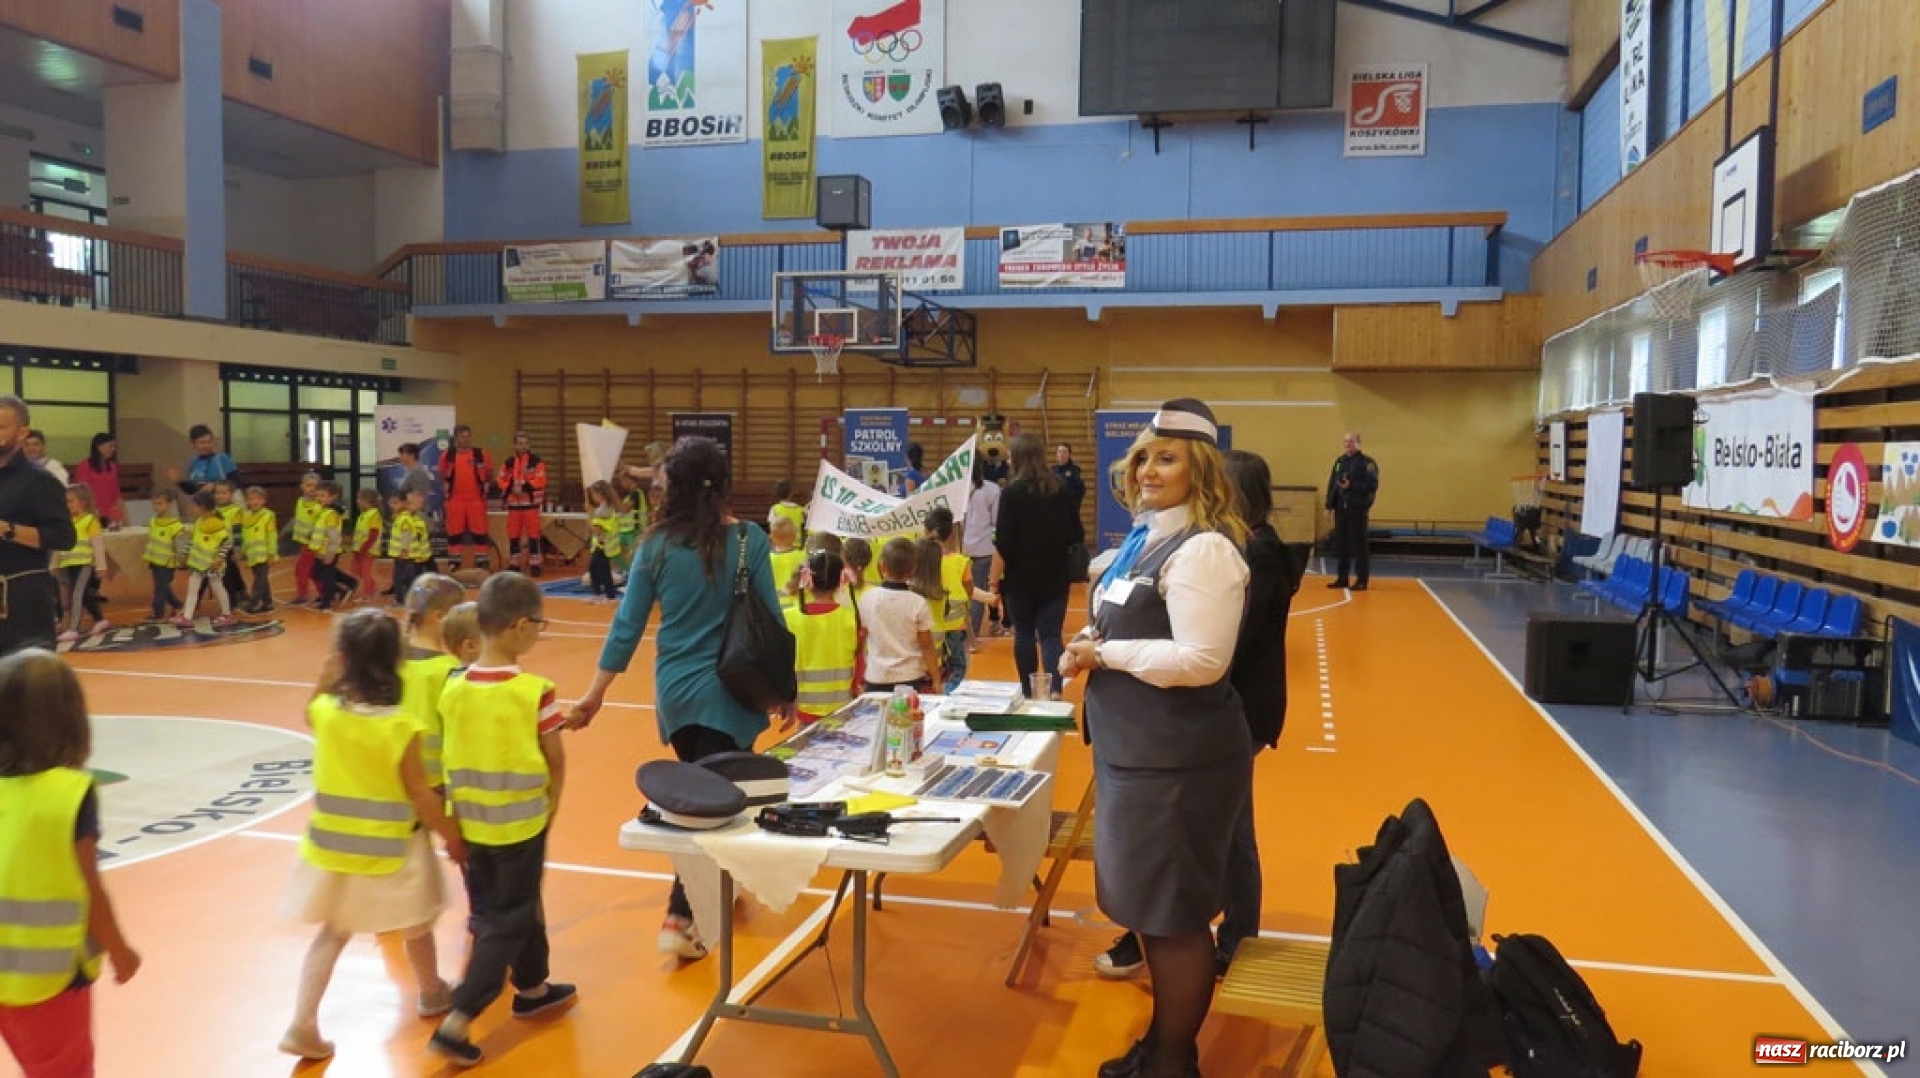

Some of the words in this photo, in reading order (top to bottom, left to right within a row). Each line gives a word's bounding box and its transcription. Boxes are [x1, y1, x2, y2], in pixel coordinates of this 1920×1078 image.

[645, 115, 743, 138] BBOSiR
[872, 233, 942, 251] TWOJA
[855, 253, 957, 271] REKLAMA
[854, 428, 899, 440] PATROL
[850, 440, 903, 453] SZKOLNY
